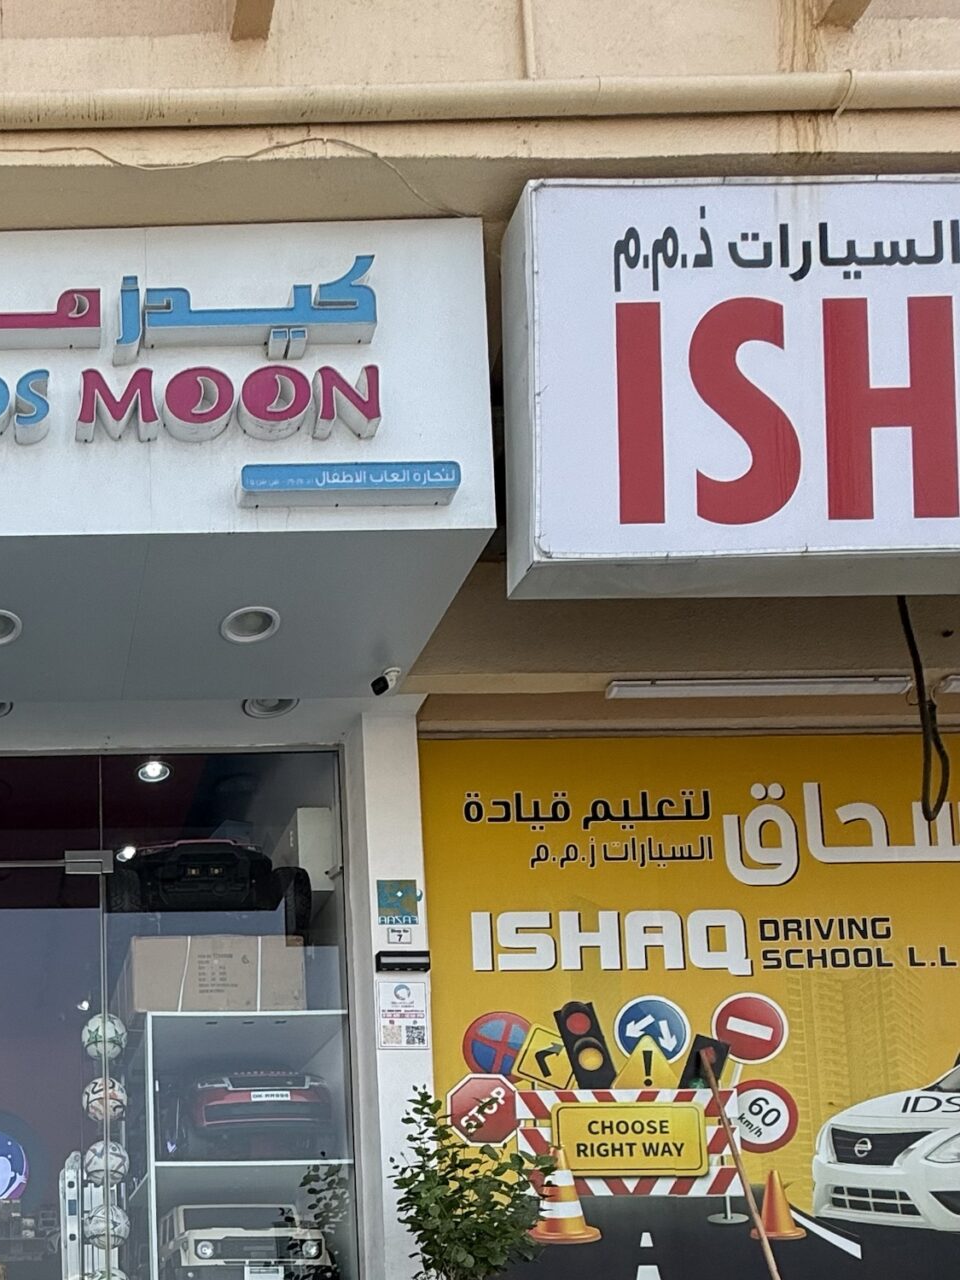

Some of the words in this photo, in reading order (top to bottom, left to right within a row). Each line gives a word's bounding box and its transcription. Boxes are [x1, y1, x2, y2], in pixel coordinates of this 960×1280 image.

[728, 219, 960, 282] السيارات
[115, 254, 378, 345] كيدز
[77, 364, 381, 424] MOON
[614, 295, 960, 525] ISH
[463, 792, 571, 831] قيادة
[582, 789, 711, 830] لتعليم
[602, 836, 714, 868] السيارات
[396, 933, 403, 943] 7
[471, 909, 753, 976] ISHAQ
[758, 917, 892, 942] DRIVING
[762, 947, 894, 970] SCHOOL
[587, 1120, 670, 1136] CHOOSE
[748, 1096, 782, 1128] 60
[576, 1142, 637, 1158] RIGHT
[642, 1142, 685, 1157] WAY
